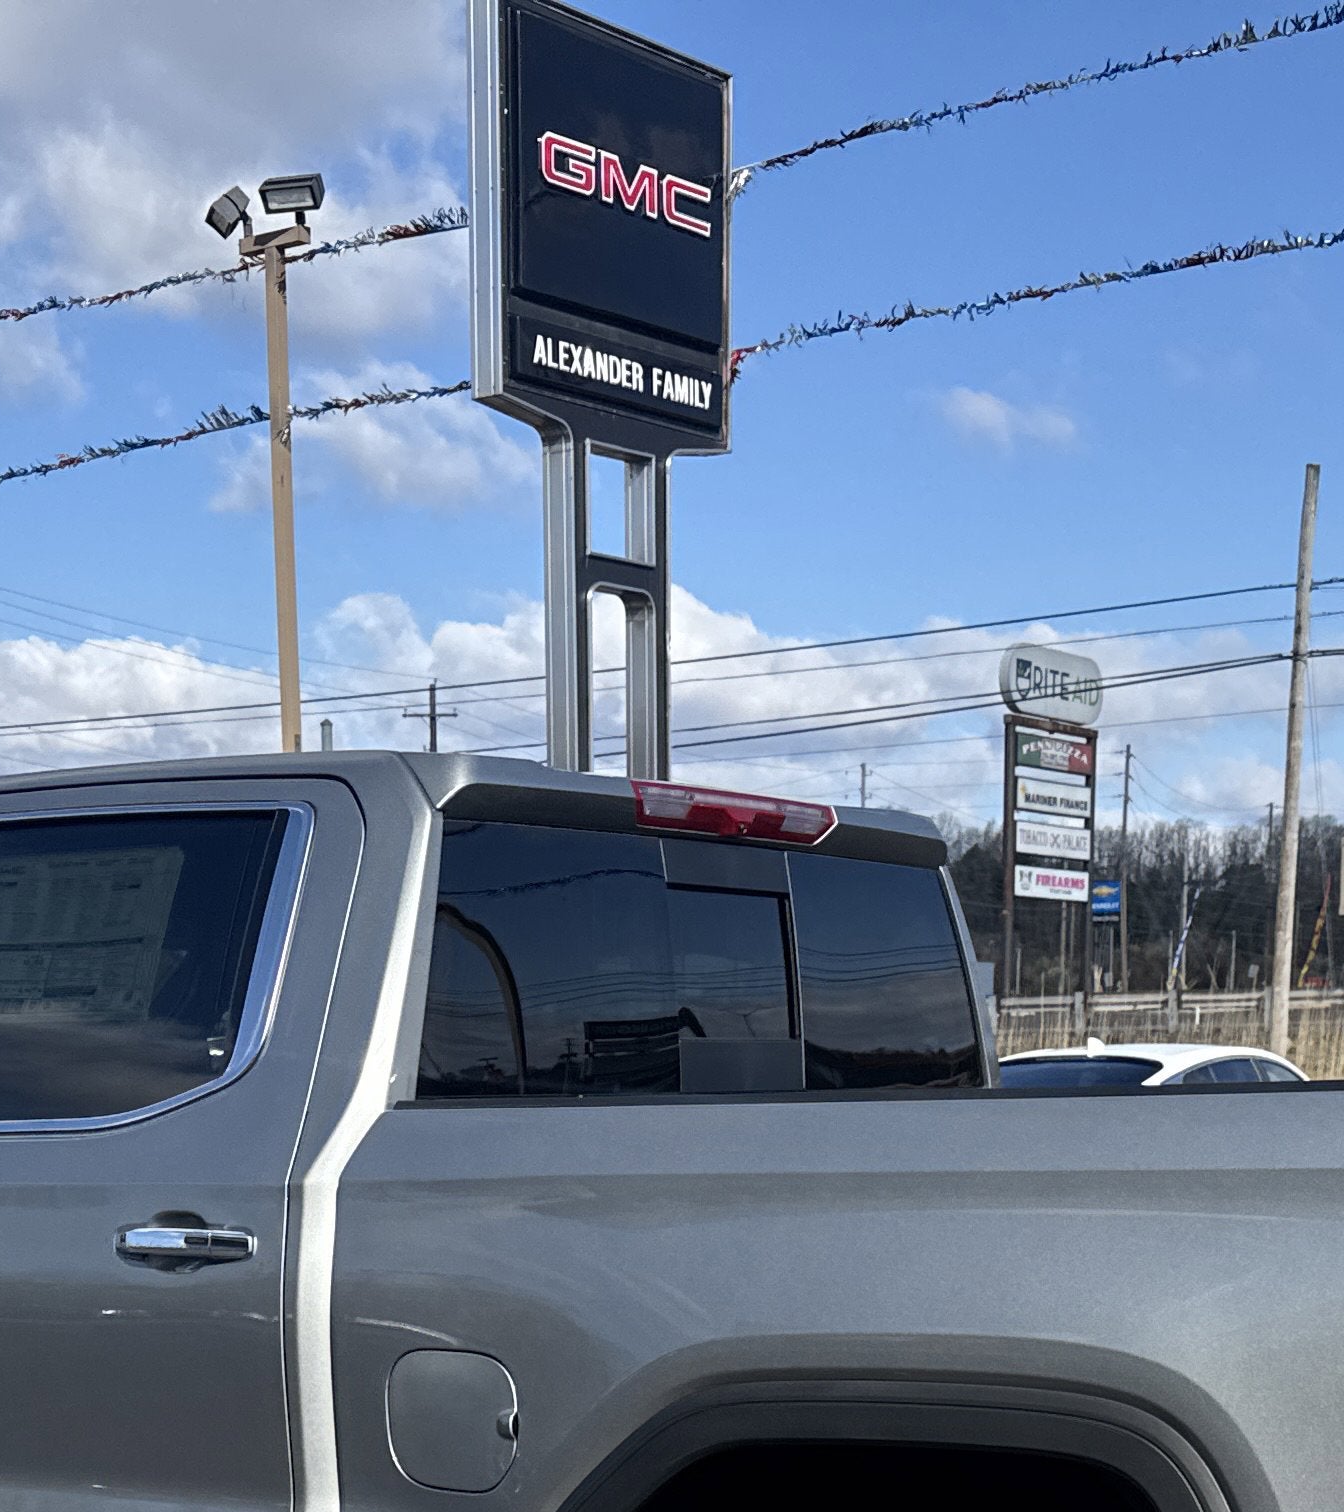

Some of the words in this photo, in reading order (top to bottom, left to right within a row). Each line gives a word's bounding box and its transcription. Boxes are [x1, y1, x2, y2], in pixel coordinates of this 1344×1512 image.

[538, 130, 712, 238] GMC
[532, 334, 644, 393] ALEXANDER
[652, 367, 713, 410] FAMILY
[1033, 665, 1070, 701] RITE
[1072, 676, 1100, 706] AID
[1024, 792, 1058, 808] MARINER
[1059, 797, 1088, 811] FINANCE
[1035, 872, 1086, 891] FIREARMS
